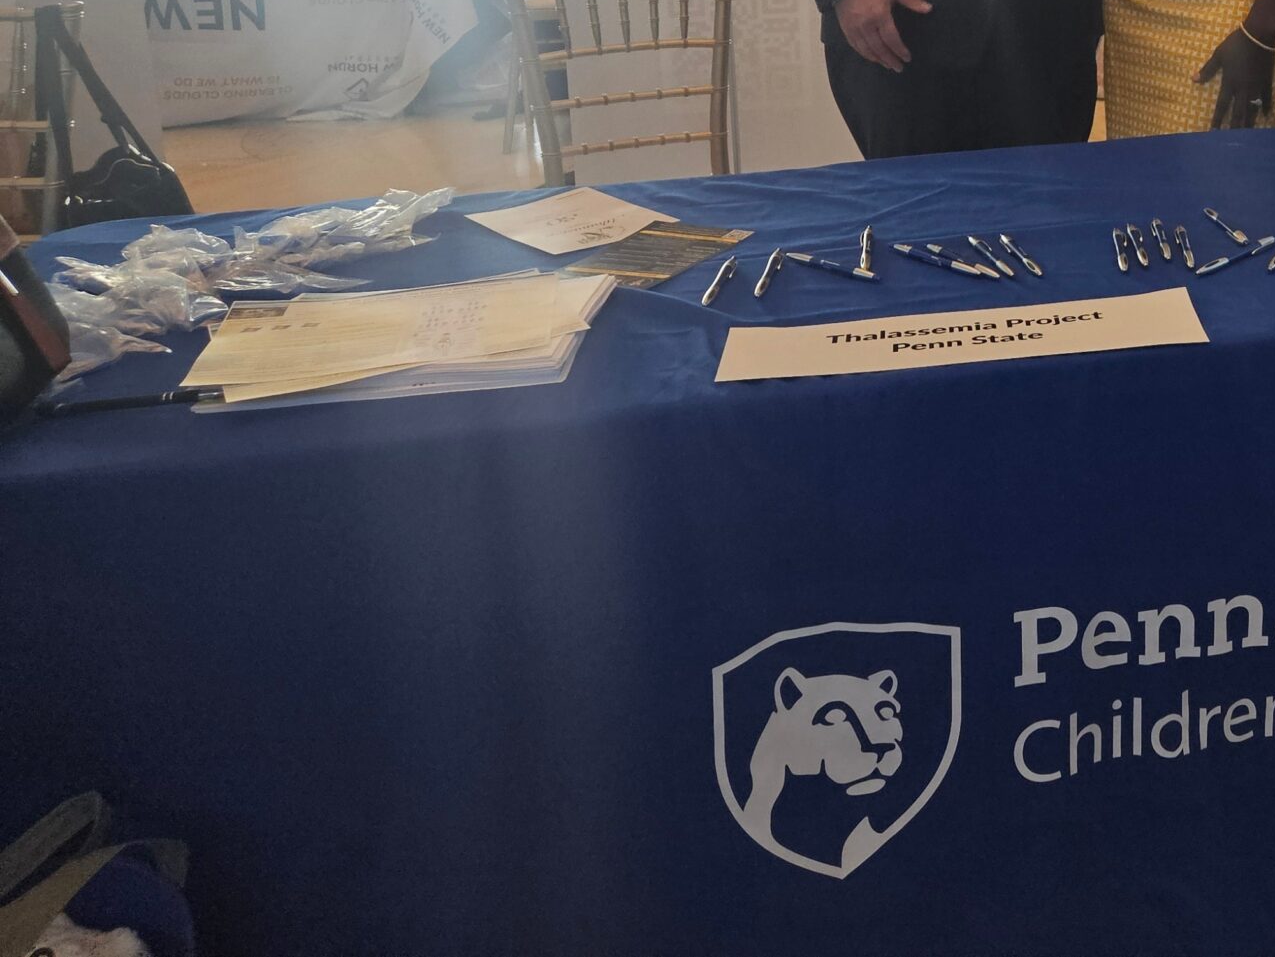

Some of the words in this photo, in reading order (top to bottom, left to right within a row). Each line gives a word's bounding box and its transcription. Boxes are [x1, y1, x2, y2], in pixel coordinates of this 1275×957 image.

[173, 76, 193, 87] DO
[196, 77, 217, 88] WE
[220, 76, 263, 87] WHAT
[162, 88, 220, 100] CLOUDS
[826, 321, 997, 344] Thalassemia
[1005, 310, 1104, 329] Project
[892, 338, 963, 353] Penn
[971, 331, 1044, 346] State
